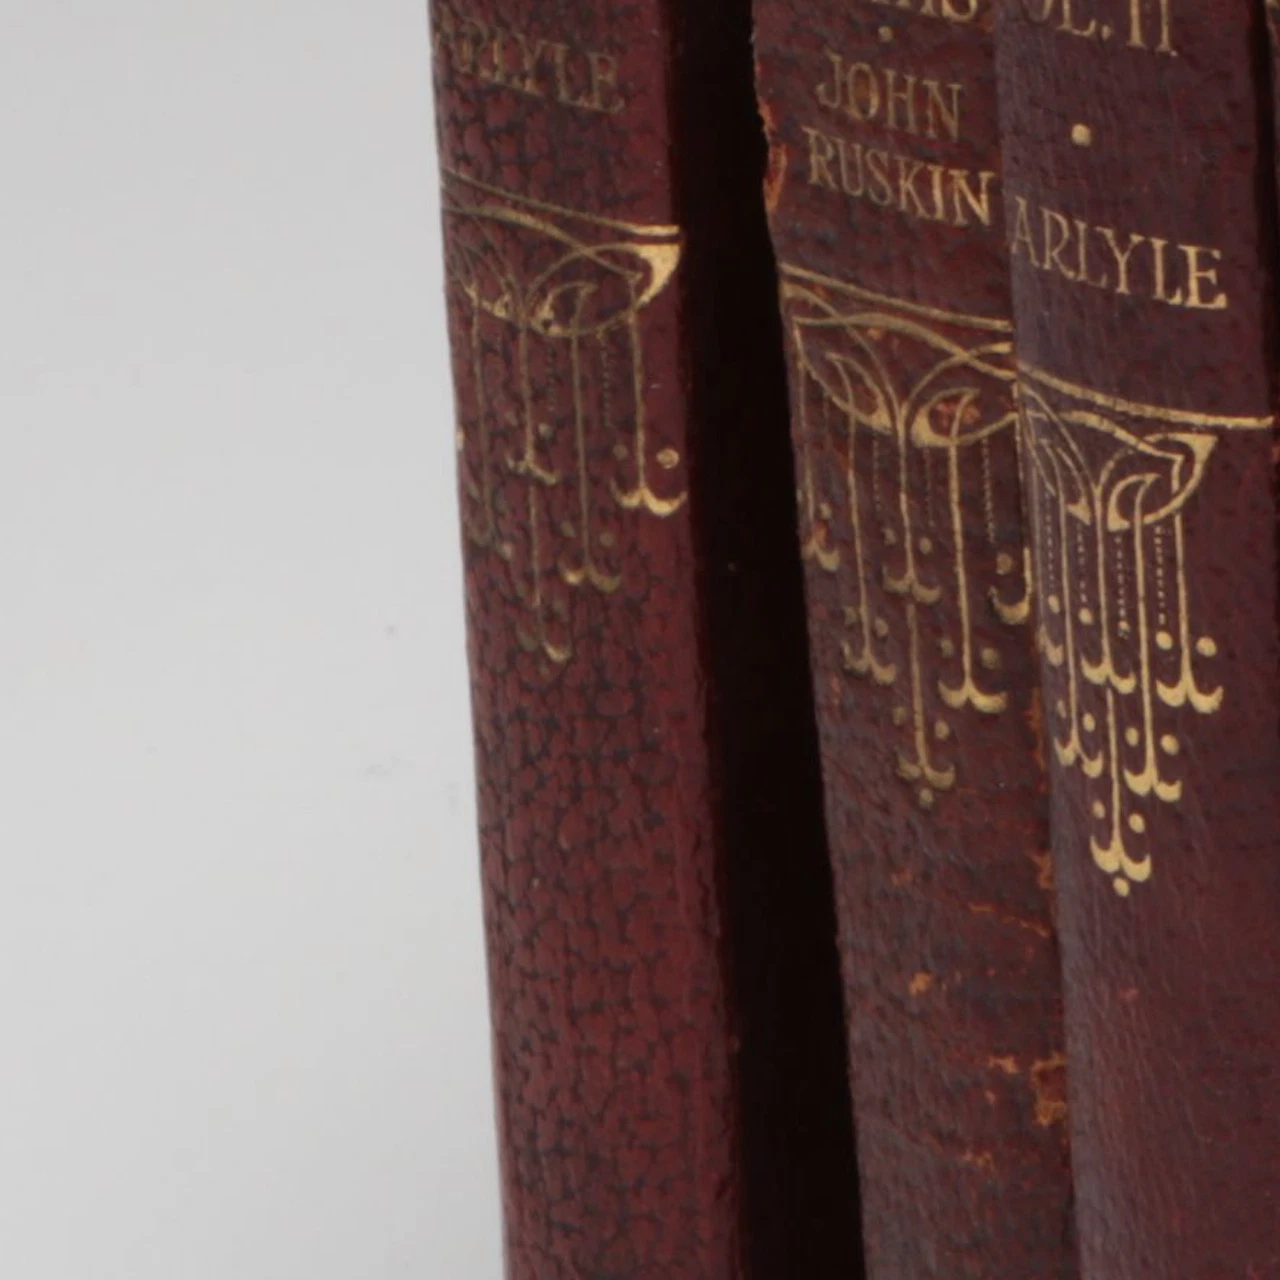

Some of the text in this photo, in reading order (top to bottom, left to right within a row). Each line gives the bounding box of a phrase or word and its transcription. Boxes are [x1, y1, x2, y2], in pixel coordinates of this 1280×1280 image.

[814, 45, 965, 144] JOHN
[800, 124, 997, 230] RUSKIN
[1011, 194, 1231, 311] ARLYLE
